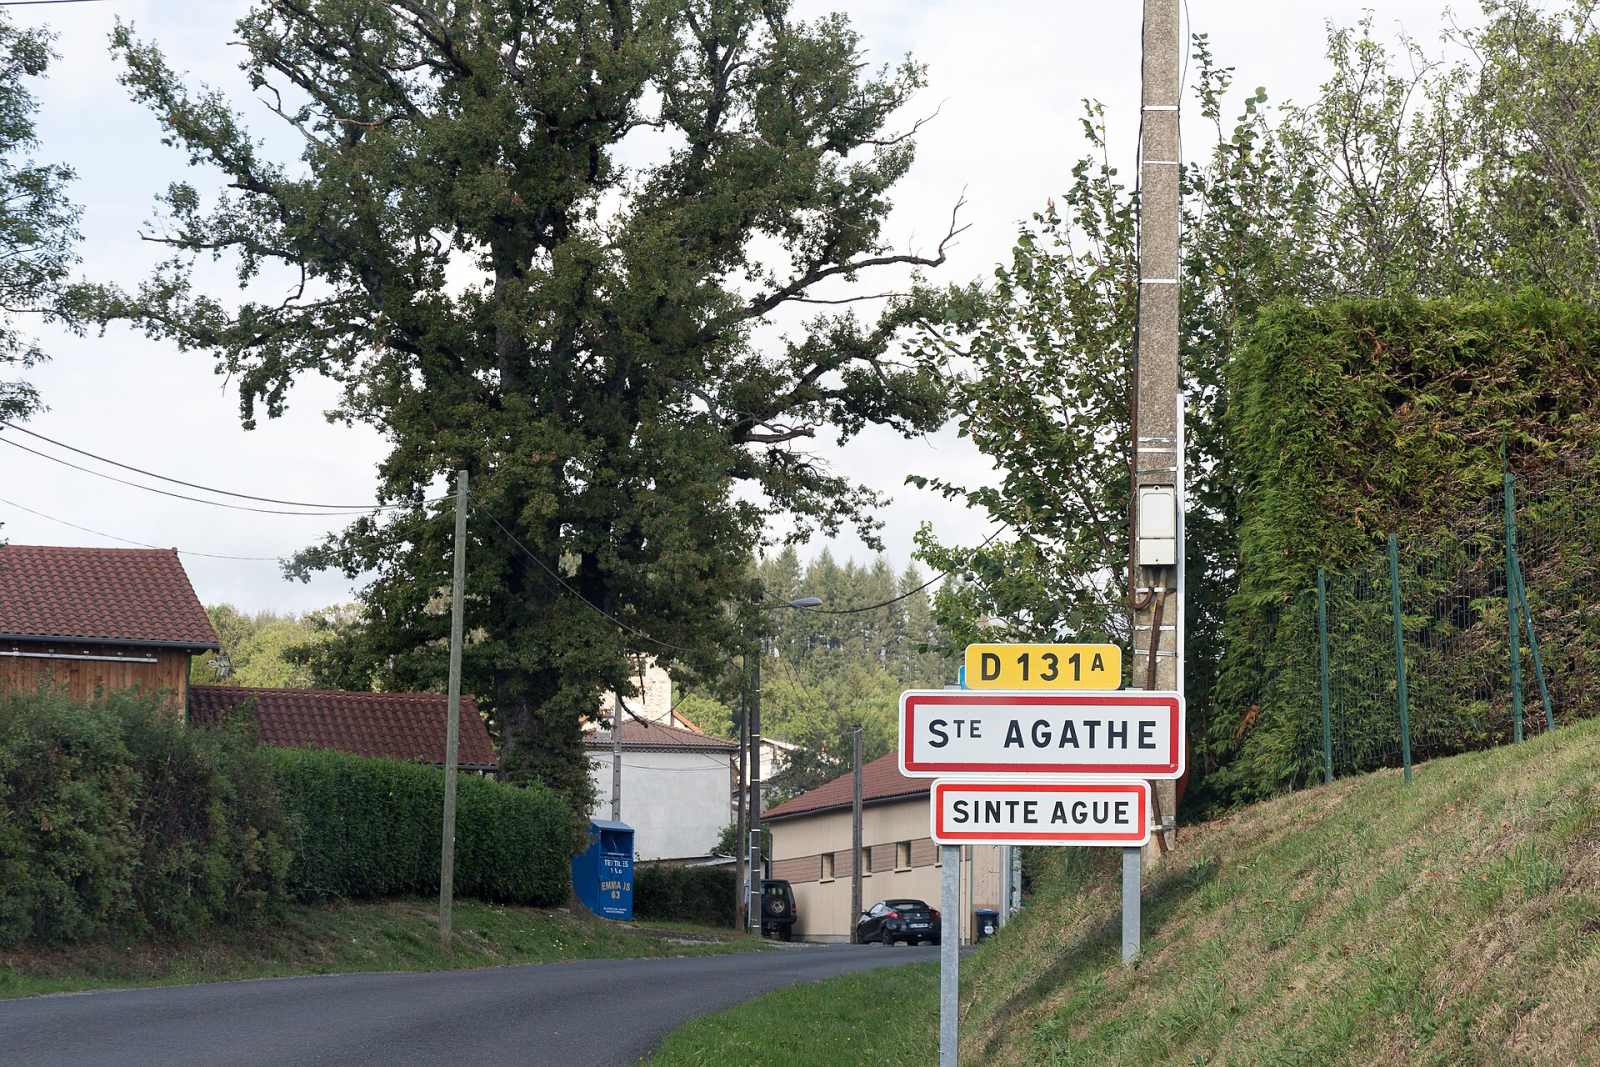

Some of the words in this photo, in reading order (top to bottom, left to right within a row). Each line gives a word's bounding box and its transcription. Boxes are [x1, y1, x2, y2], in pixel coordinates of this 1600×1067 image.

[981, 653, 1001, 681] D
[1017, 652, 1105, 681] 131A
[1003, 719, 1157, 749] AGATHE
[952, 800, 1038, 824] SINTE
[1050, 800, 1129, 825] AGUE
